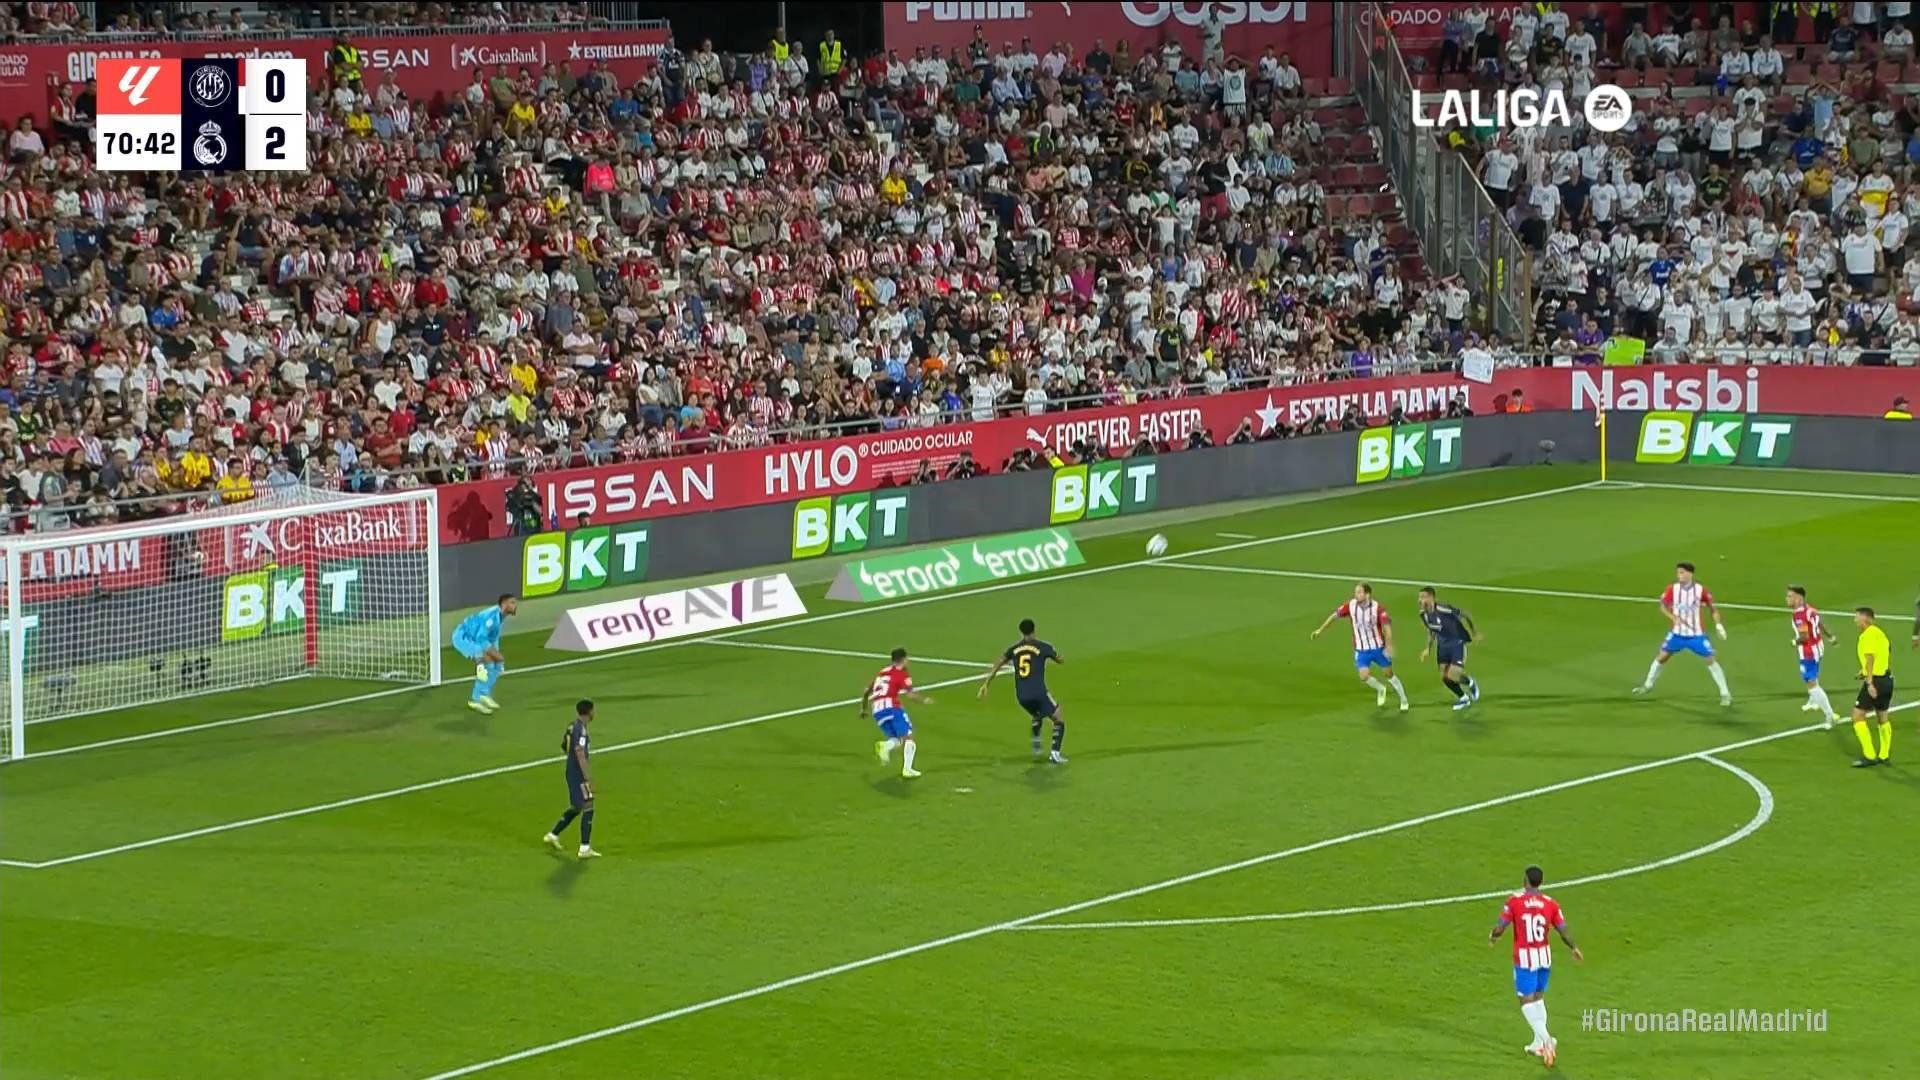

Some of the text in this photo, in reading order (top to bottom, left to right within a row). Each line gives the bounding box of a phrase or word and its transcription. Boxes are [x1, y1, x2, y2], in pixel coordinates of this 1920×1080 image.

[324, 48, 429, 69] NSSAN
[478, 47, 538, 65] CaixaBank
[584, 44, 666, 59] ESTRELLA DAMM
[1571, 368, 1760, 414] Natsbi
[871, 430, 974, 457] CUIDADO OCULAR
[1359, 426, 1461, 475] BKT
[1641, 420, 1792, 458] BKT
[1052, 464, 1156, 514] BKT
[279, 508, 401, 550] CixaBank
[795, 496, 907, 549] BKT
[54, 539, 140, 577] DAMM
[526, 529, 648, 587] BKT
[226, 569, 359, 629] BKT
[587, 597, 673, 640] renfe
[1019, 654, 1031, 678] 5
[1521, 912, 1546, 943] 16
